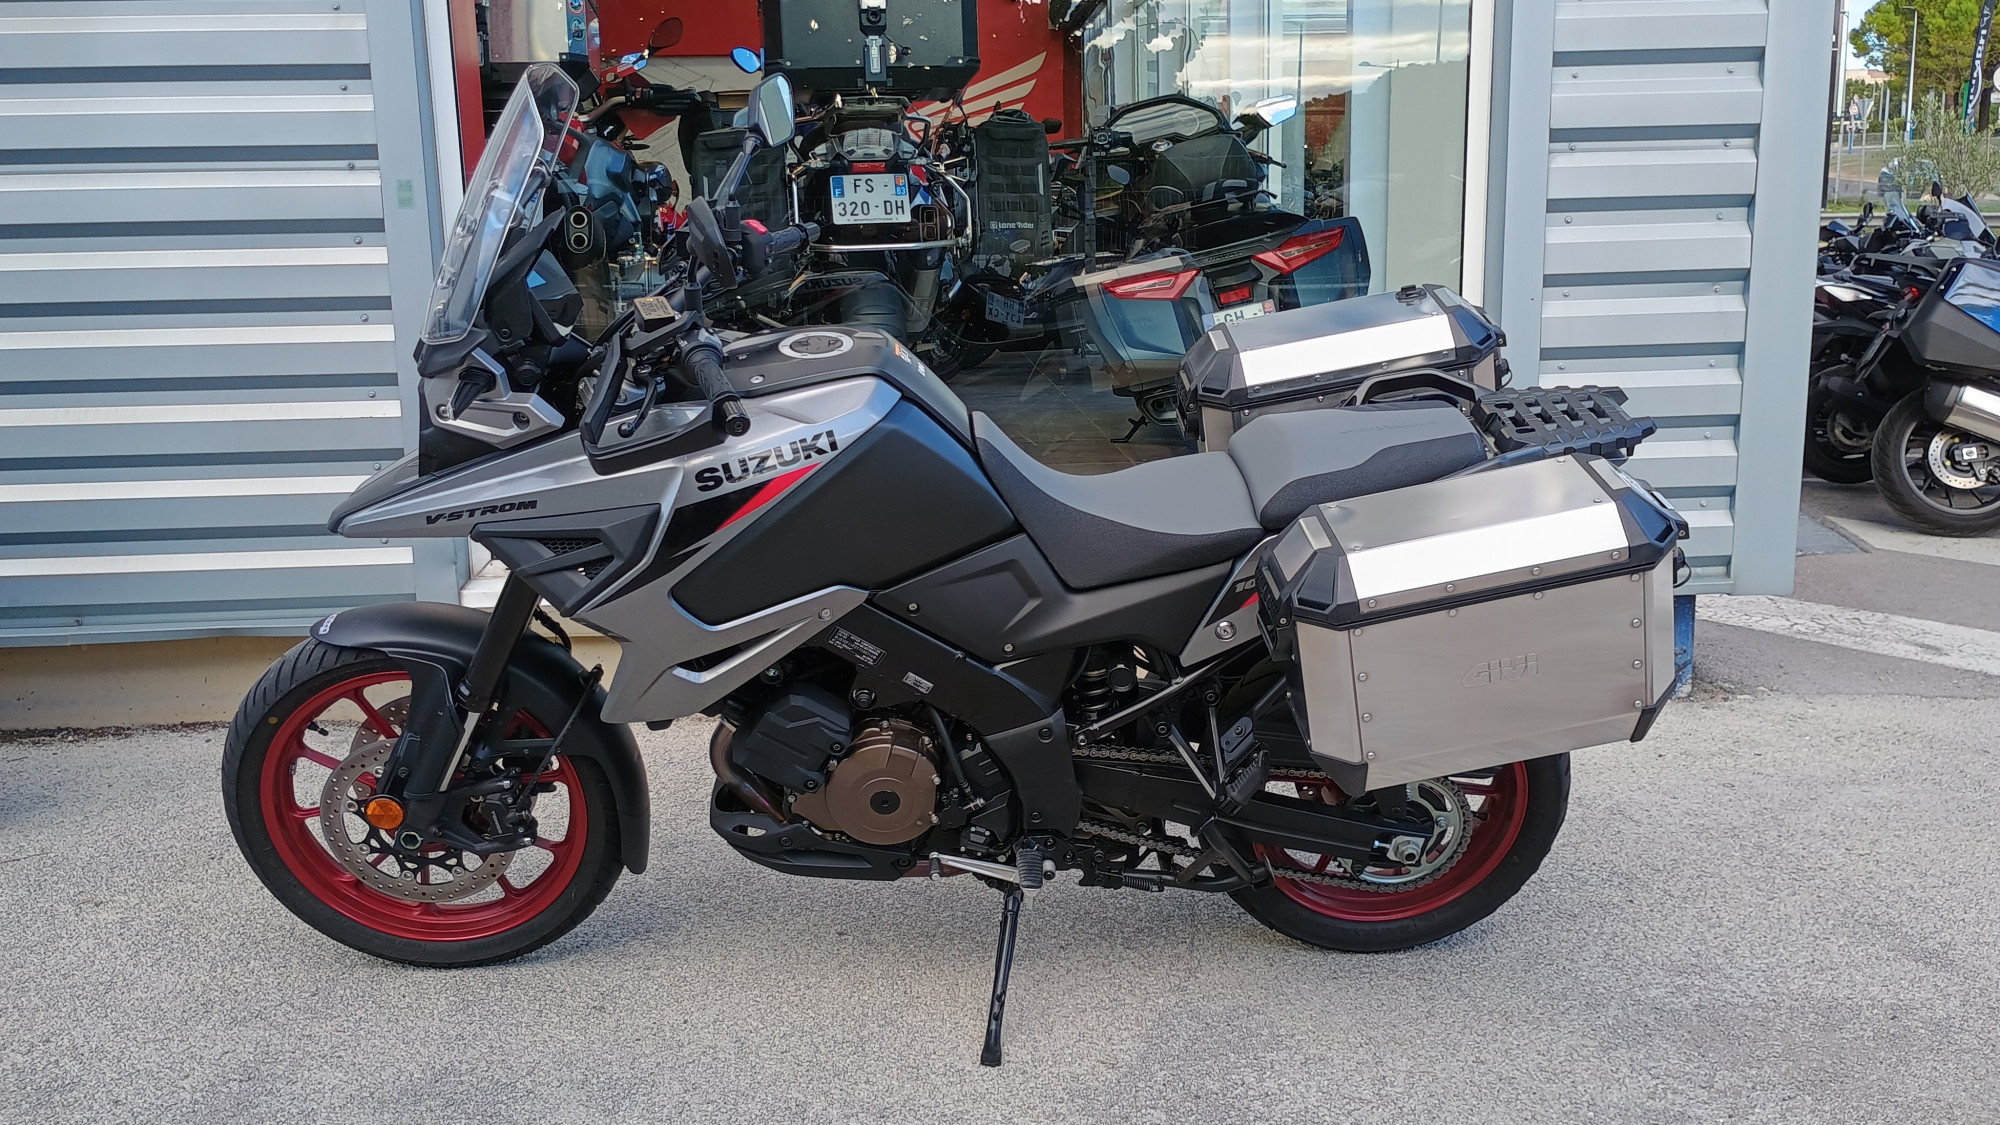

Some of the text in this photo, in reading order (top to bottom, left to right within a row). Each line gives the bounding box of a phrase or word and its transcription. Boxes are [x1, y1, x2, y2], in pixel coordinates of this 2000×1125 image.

[834, 188, 842, 198] F
[853, 178, 874, 194] FS
[896, 186, 906, 195] 83
[695, 429, 839, 493] SUZUKI
[425, 499, 538, 525] V-STROM
[1461, 651, 1539, 688] GIVI
